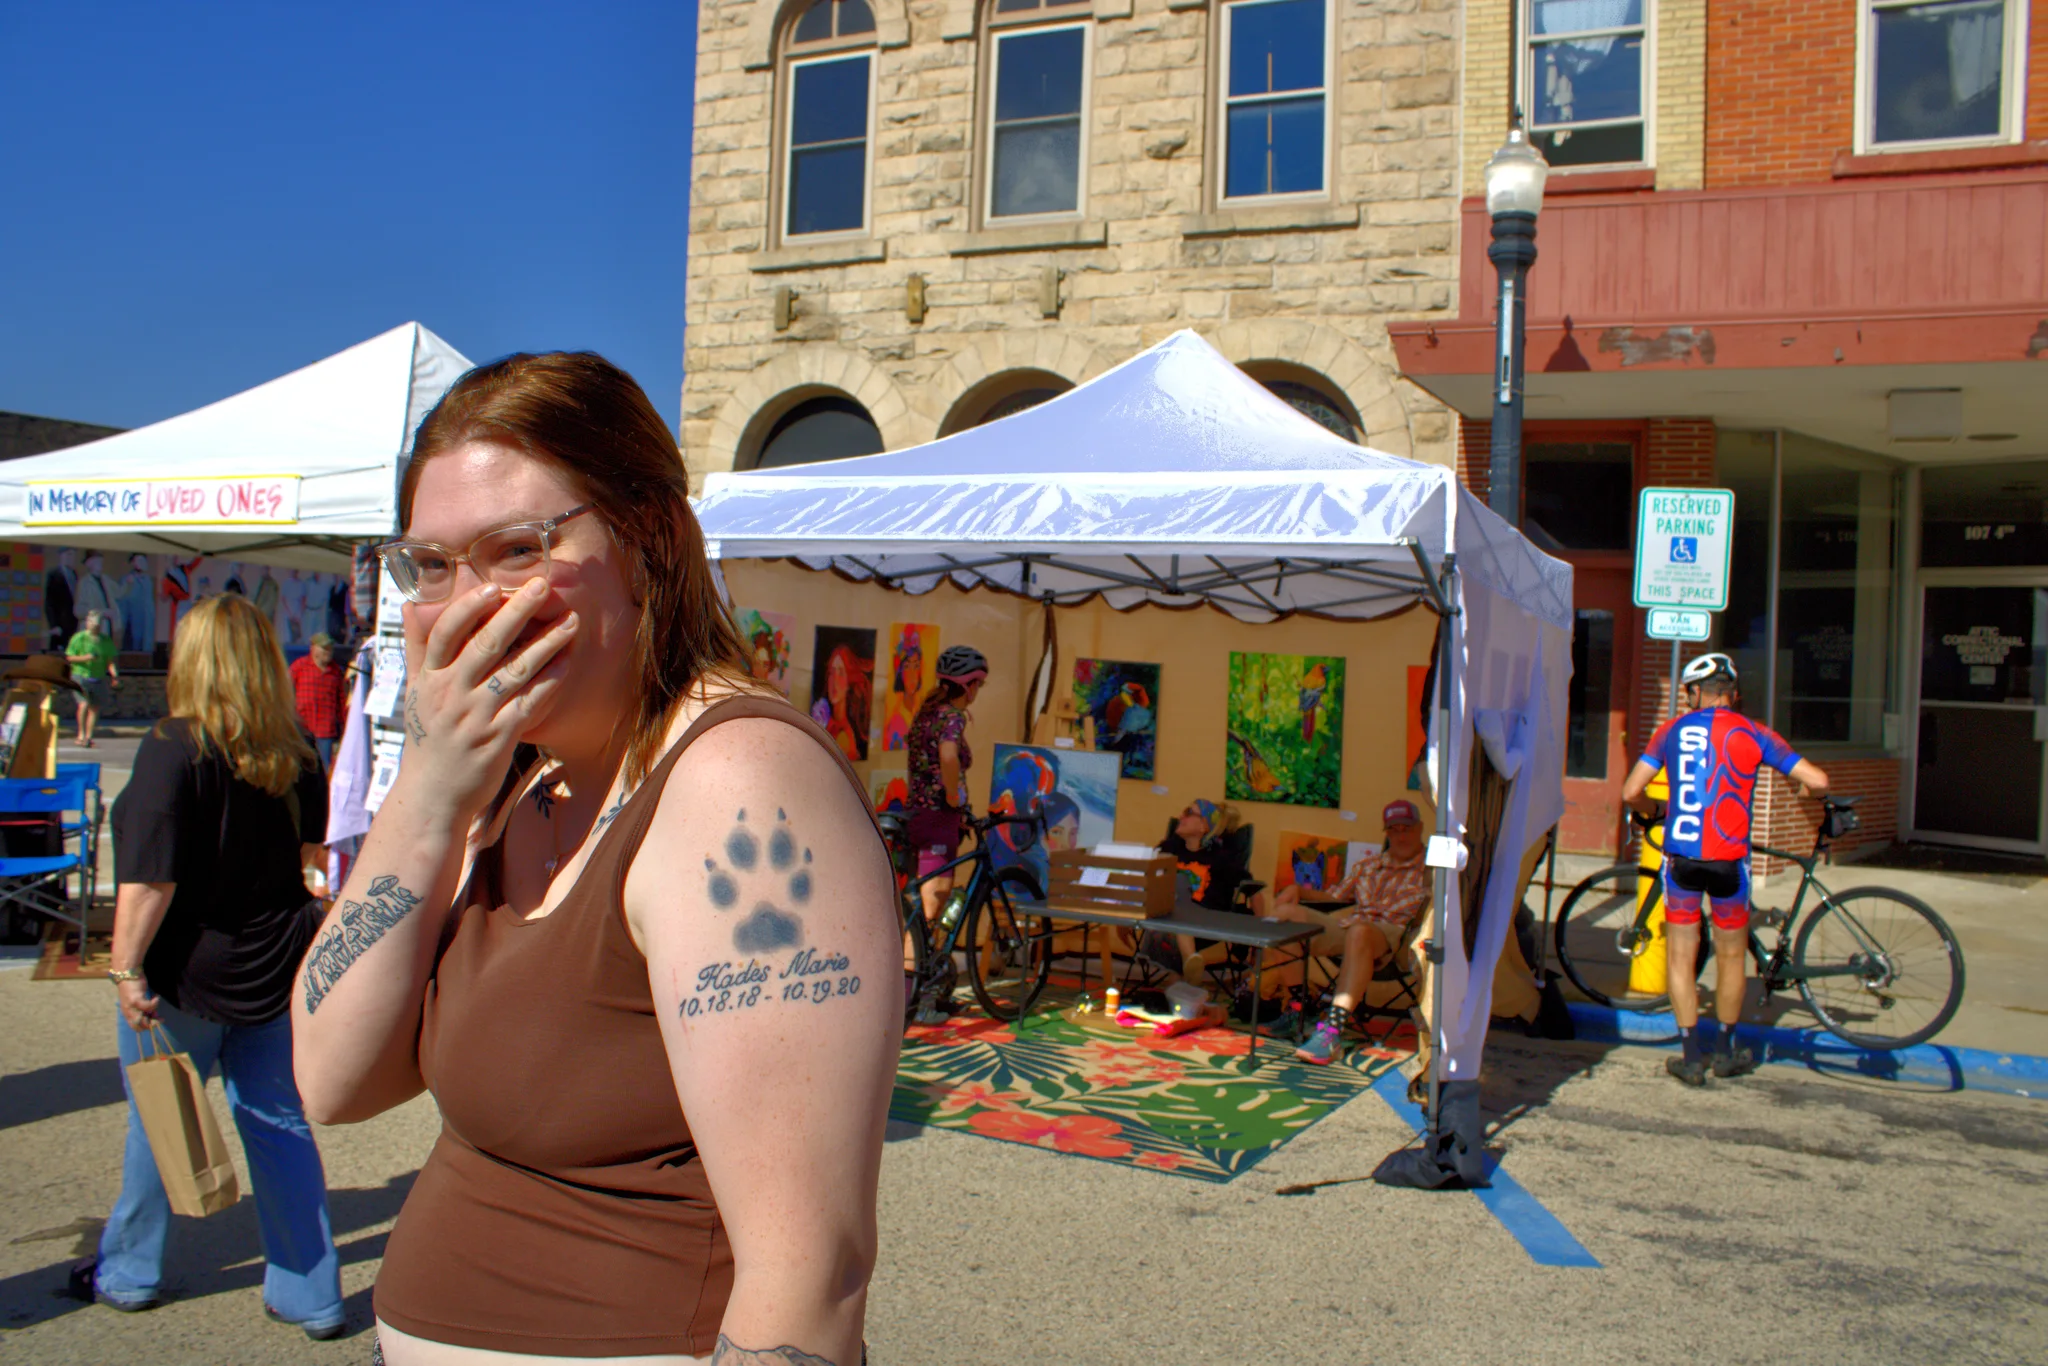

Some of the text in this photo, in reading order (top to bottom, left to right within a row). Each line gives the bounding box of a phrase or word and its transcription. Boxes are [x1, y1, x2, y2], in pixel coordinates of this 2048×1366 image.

[28, 482, 283, 518] IN MEMORY OF LOVED ONES
[1652, 497, 1721, 515] RESERVED
[1656, 518, 1715, 535] PARKING
[1964, 525, 1991, 540] 107
[1647, 585, 1716, 600] THIS SPACE
[1670, 616, 1690, 624] VAN
[696, 947, 850, 992] Hades Marie
[679, 985, 762, 1018] 10.18.18
[783, 976, 861, 1004] 10.19.20
